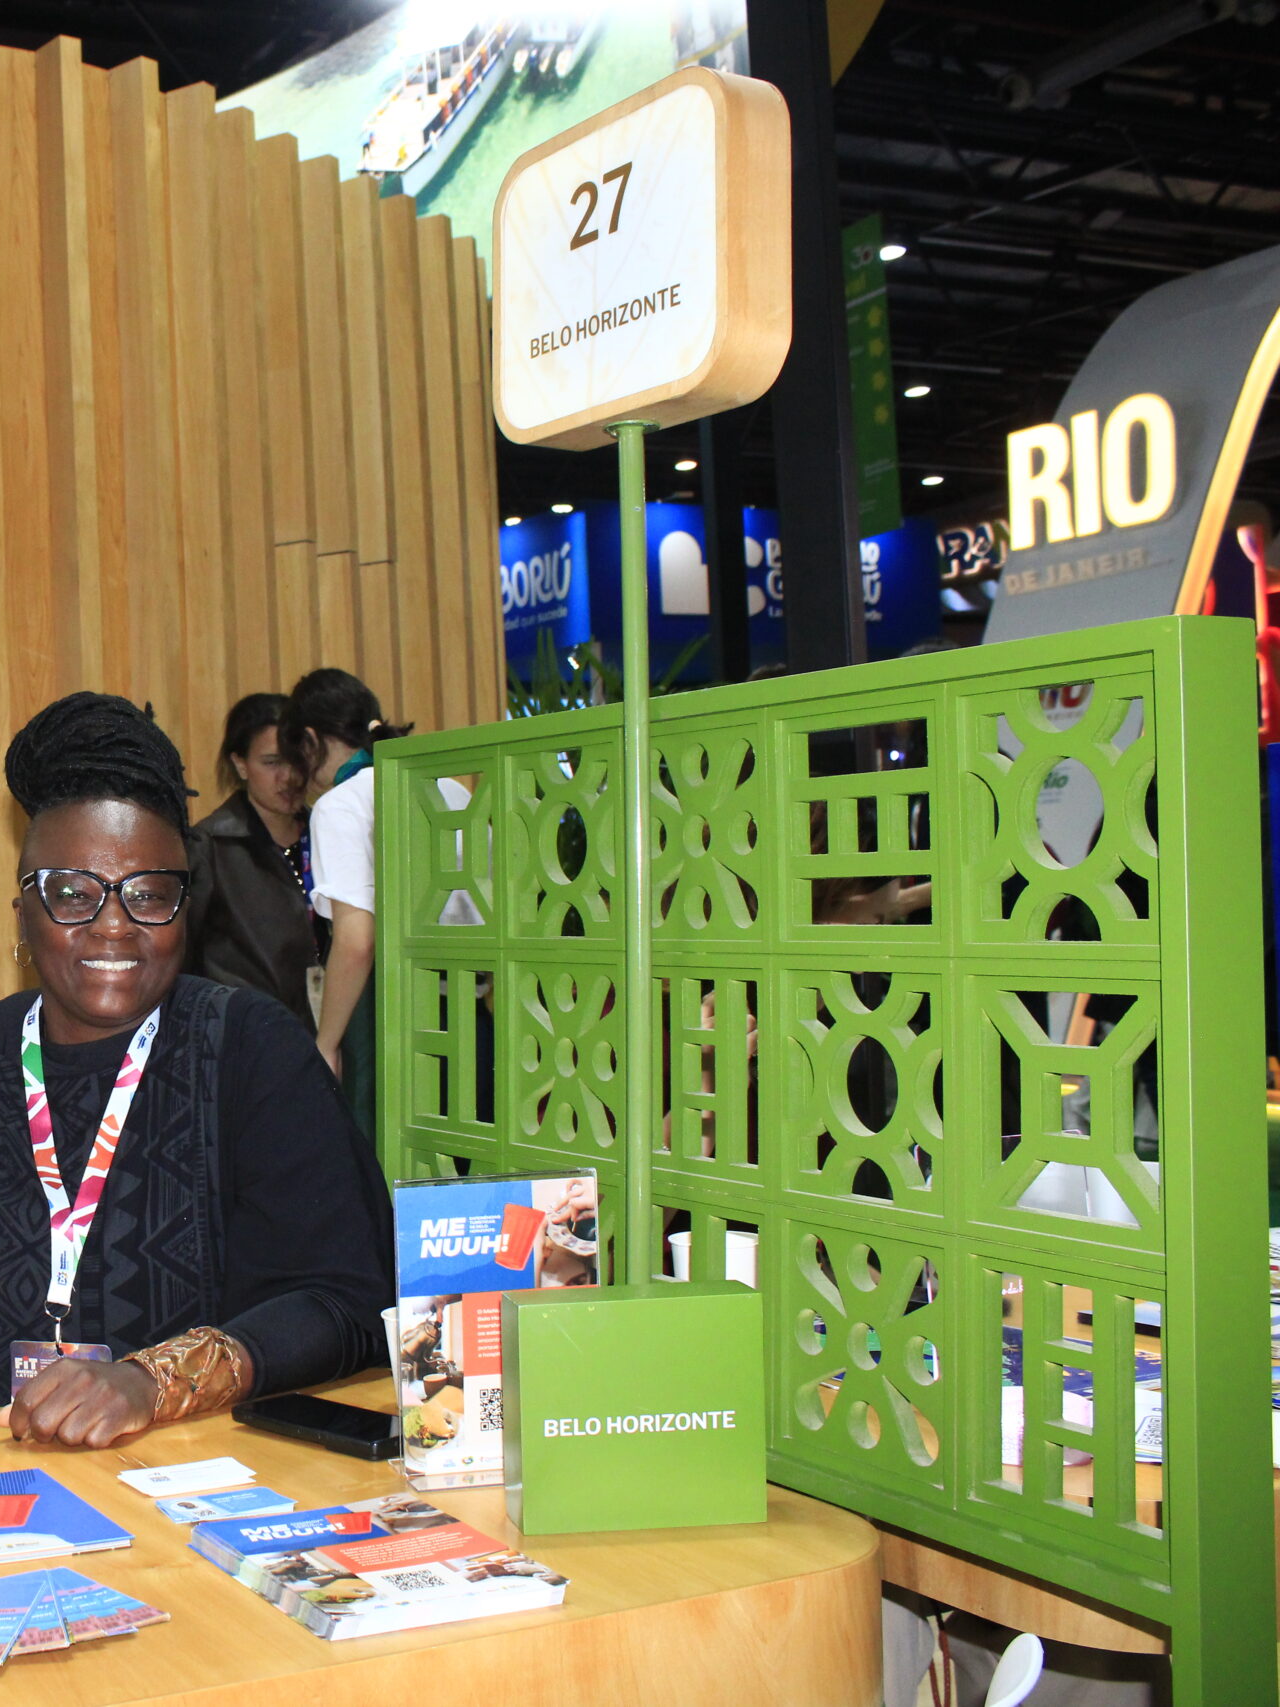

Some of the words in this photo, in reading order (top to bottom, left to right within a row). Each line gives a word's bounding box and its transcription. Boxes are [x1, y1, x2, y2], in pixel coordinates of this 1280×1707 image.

[570, 161, 633, 250] 27
[530, 325, 571, 359] BELO
[575, 283, 681, 342] HORIZONTE
[1007, 392, 1177, 551] RIO
[1005, 570, 1039, 595] DE
[1048, 547, 1150, 587] JANEIR
[420, 1217, 467, 1238] ME
[420, 1233, 510, 1258] NUUH!
[544, 1417, 602, 1438] BELO
[606, 1410, 736, 1435] HORIZONTE
[240, 1524, 290, 1536] ME
[248, 1522, 346, 1542] NUUH!
